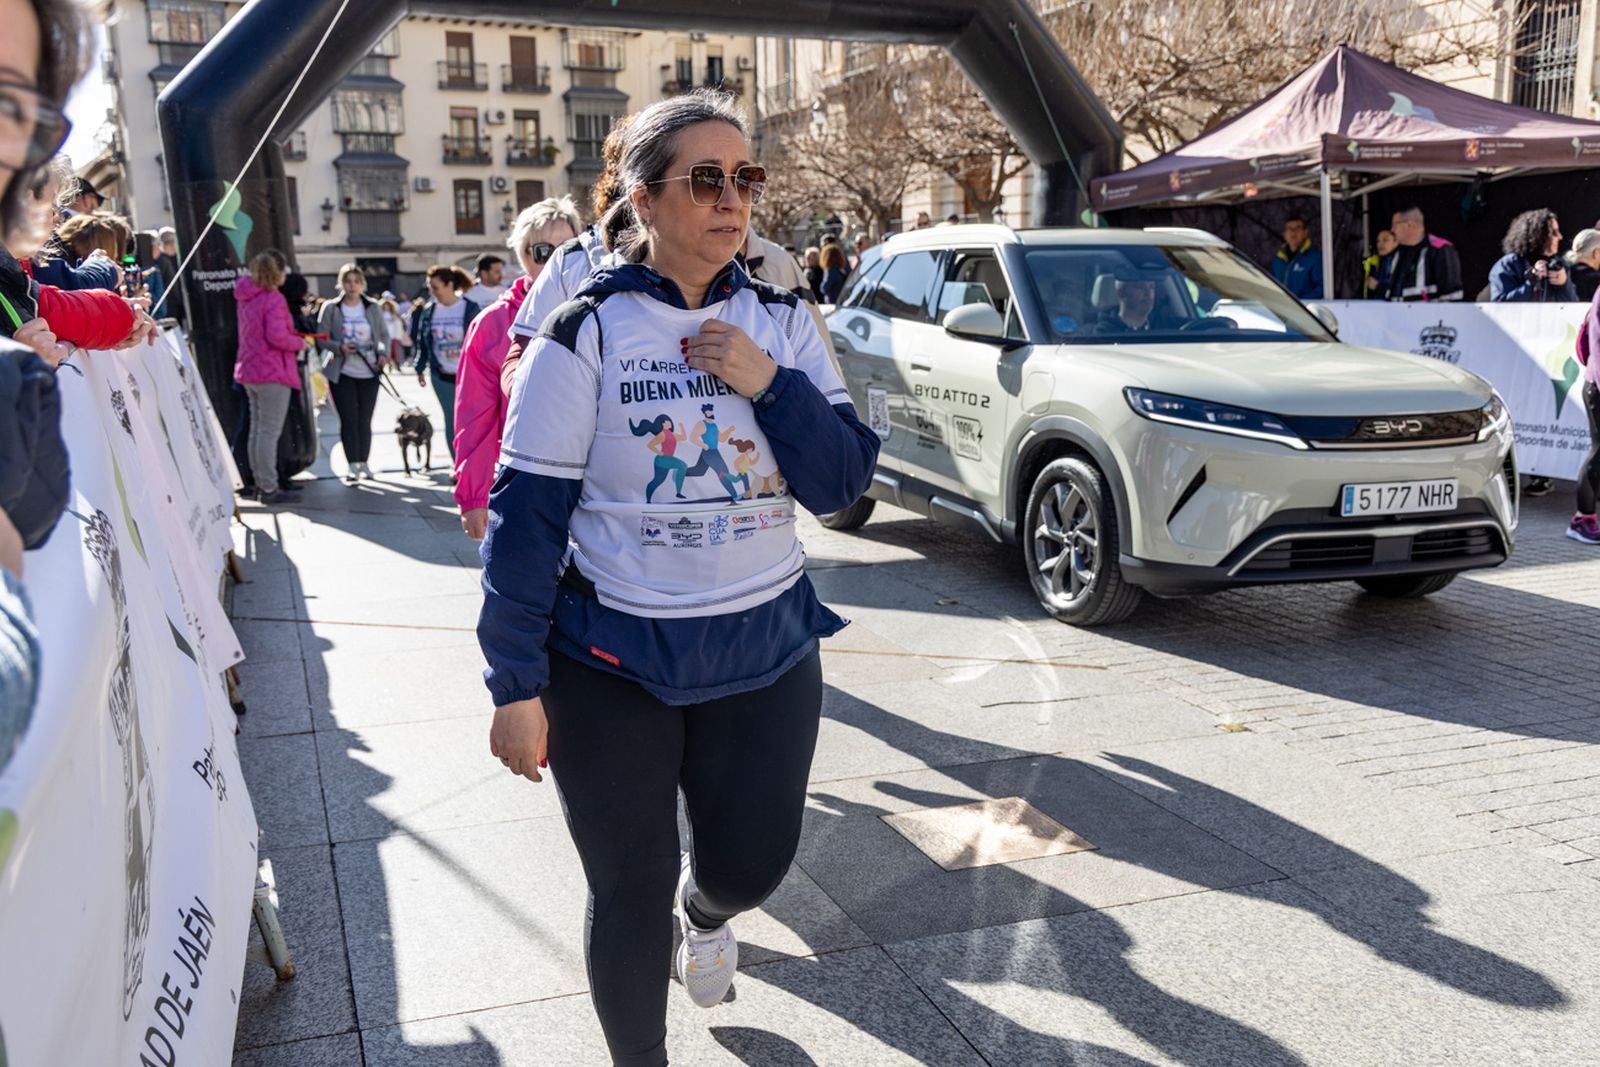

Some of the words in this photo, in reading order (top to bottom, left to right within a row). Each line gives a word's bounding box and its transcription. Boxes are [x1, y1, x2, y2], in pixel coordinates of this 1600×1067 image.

[192, 268, 236, 280] Patronato
[203, 281, 237, 292] Deport
[620, 359, 635, 372] VI
[639, 358, 699, 375] CARRE
[620, 379, 684, 404] BUENA
[686, 374, 738, 398] MUE
[914, 384, 940, 400] BYD
[942, 389, 978, 407] ATTO
[981, 395, 991, 409] 2
[1372, 419, 1423, 435] BYD
[1514, 422, 1548, 434] tronato
[1549, 424, 1589, 439] Municip
[1556, 439, 1569, 450] de
[1359, 486, 1412, 511] 5177
[1417, 483, 1455, 508] NHR
[173, 896, 217, 990] JAÉN
[154, 972, 193, 1040] DE
